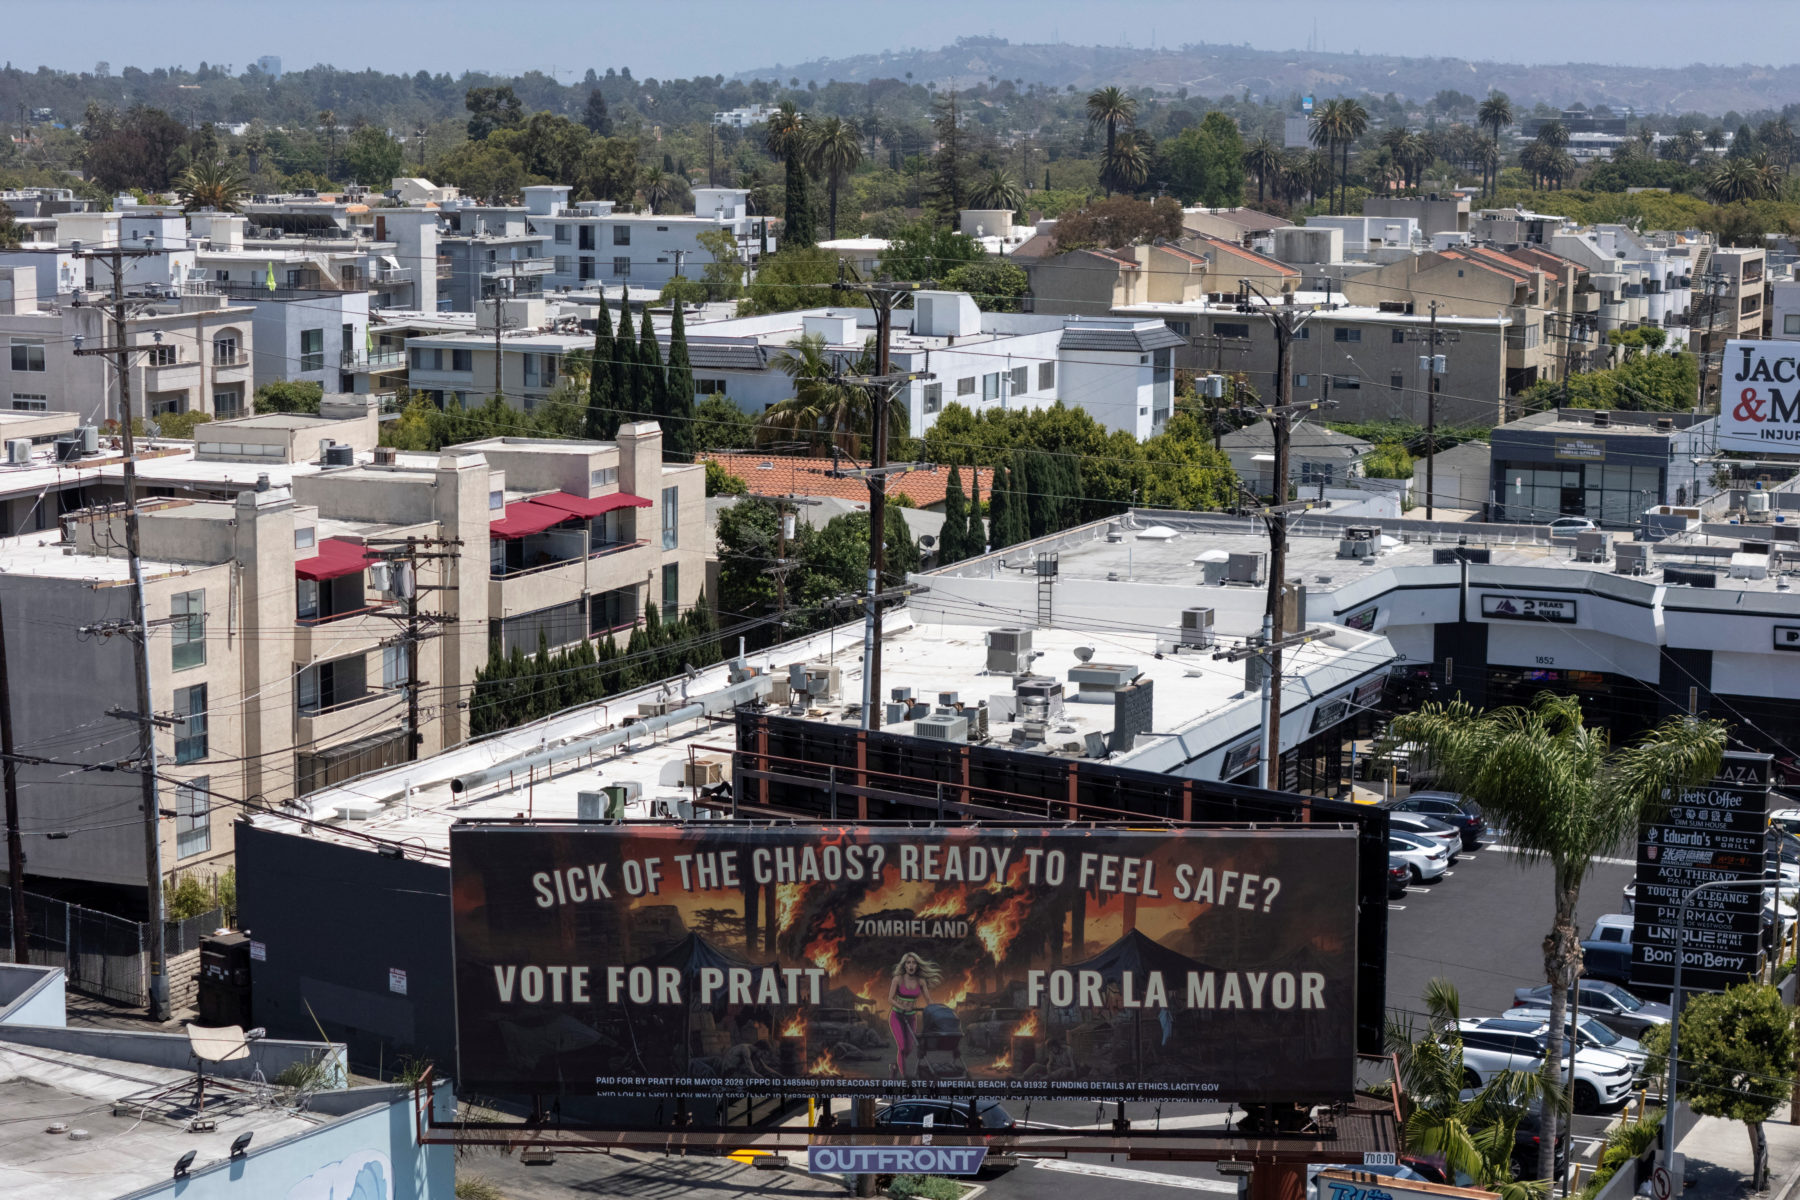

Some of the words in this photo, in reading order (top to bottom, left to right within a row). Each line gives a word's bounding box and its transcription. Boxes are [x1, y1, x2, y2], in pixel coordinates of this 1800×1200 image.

[1735, 347, 1800, 383] JAC
[1539, 601, 1564, 609] PEAKS
[1535, 656, 1554, 665] 1852
[1708, 790, 1742, 808] Coffee
[1705, 821, 1727, 829] HOUSE
[1663, 828, 1711, 847] Eduardo's
[1715, 835, 1756, 845] BORDER
[532, 862, 612, 909] SICK
[622, 857, 662, 897] OF
[674, 850, 741, 891] THE
[753, 844, 886, 884] CHAOS?
[899, 844, 1013, 884] READY
[1024, 848, 1066, 886] TO
[1079, 853, 1159, 897] FEEL
[1172, 863, 1282, 913] SAFE?
[1658, 867, 1682, 878] ACU
[1685, 869, 1739, 882] THERAPY
[1667, 877, 1691, 886] PAIN
[1647, 886, 1679, 898] TOUCH
[1697, 890, 1749, 904] ELEGANCE
[1669, 898, 1695, 907] NAIS
[1707, 901, 1725, 910] SPA
[854, 920, 969, 939] ZOMBIELAND
[1648, 926, 1716, 944] UNIQUE
[1717, 932, 1743, 940] PRINT
[494, 965, 590, 1003] VOTE
[608, 966, 683, 1004] FOR
[700, 967, 825, 1005] PRATT
[1027, 969, 1103, 1008] FOR
[1122, 970, 1168, 1009] LA
[1186, 971, 1326, 1010] MAYOR
[596, 1077, 615, 1085] PAID
[617, 1077, 634, 1085] FOR
[635, 1077, 646, 1085] BY
[648, 1077, 674, 1085] PRATT
[675, 1077, 692, 1086] FOR
[694, 1078, 723, 1086] MAYOR
[725, 1078, 744, 1086] 2026
[746, 1078, 770, 1087] (FPPC
[772, 1078, 781, 1086] ID
[820, 1079, 835, 1087] 970
[837, 1079, 880, 1087] SEACOAST
[882, 1079, 910, 1089] DRIVE,
[911, 1080, 927, 1088] STE
[937, 1080, 975, 1088] IMPERIAL
[1023, 1081, 1047, 1089] 91932
[1051, 1081, 1089, 1089] FUNDING
[1090, 1082, 1124, 1090] DETAILS
[1126, 1082, 1137, 1090] AT
[1138, 1082, 1219, 1092] ETHICS.LACITY.GOV
[814, 1149, 978, 1171] OUTFRONT
[1365, 1153, 1394, 1165] 70090
